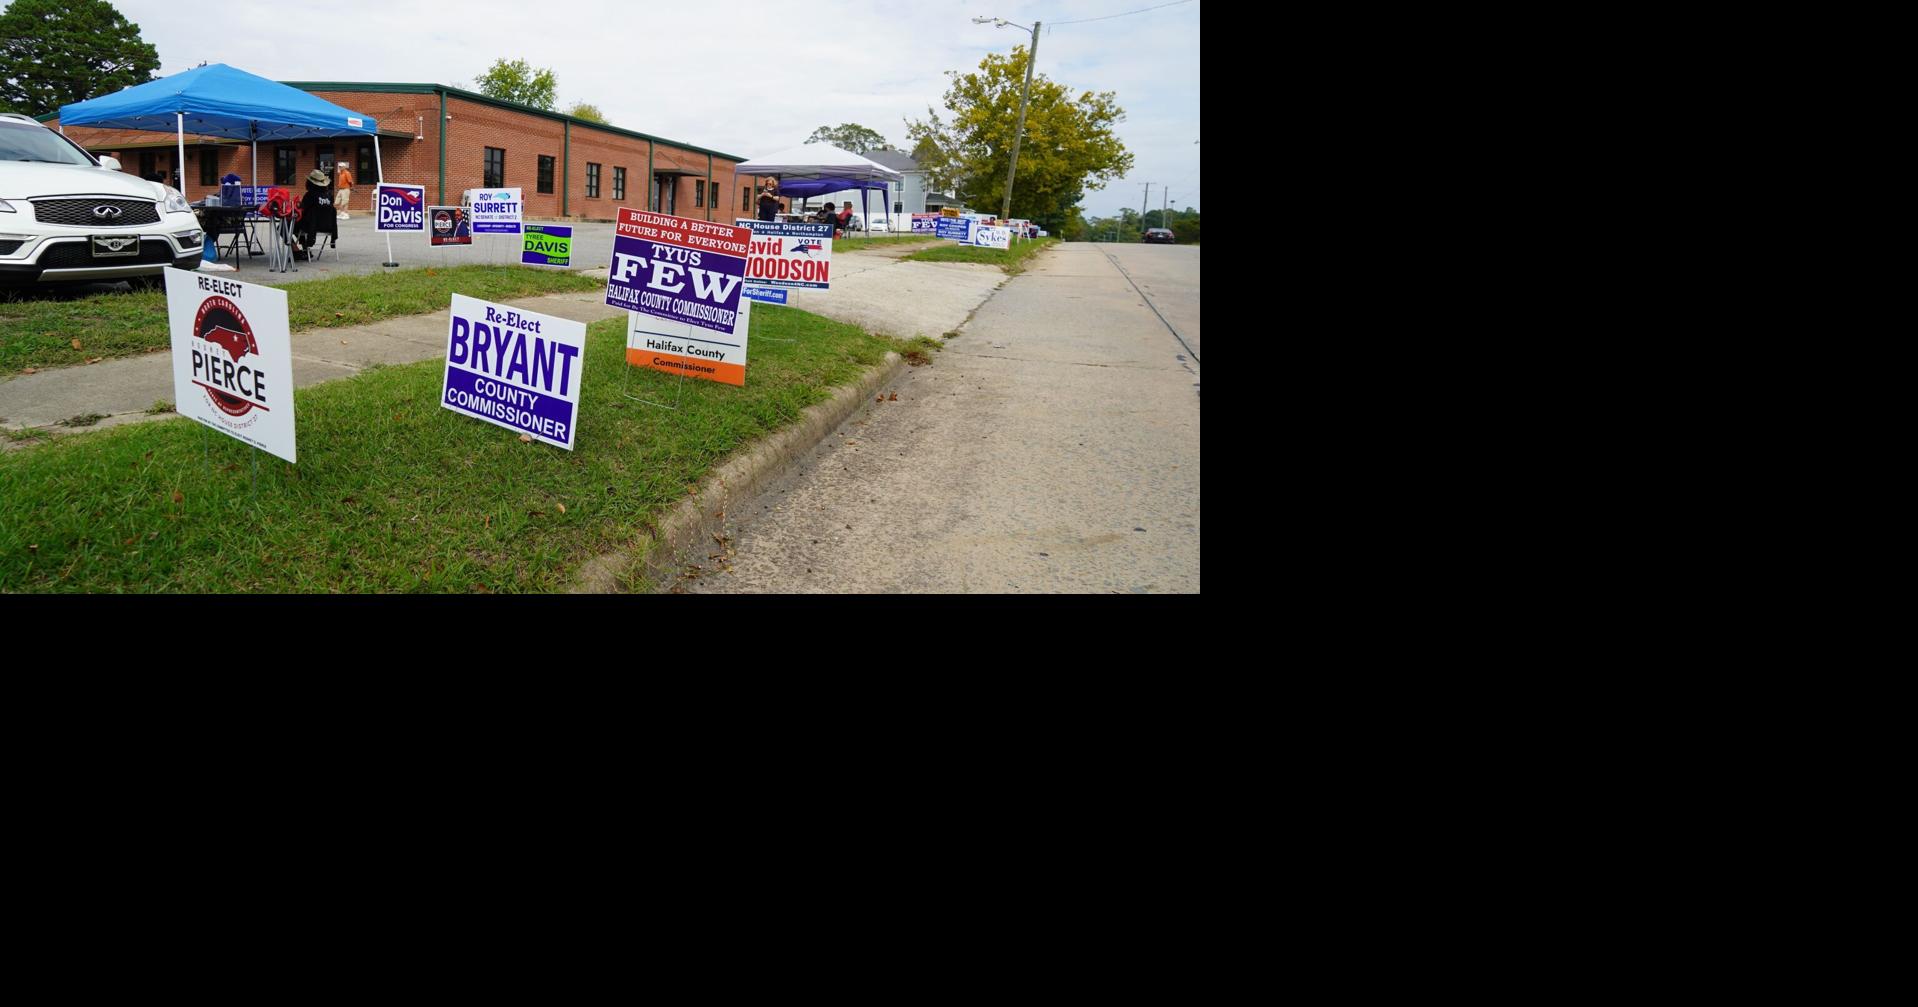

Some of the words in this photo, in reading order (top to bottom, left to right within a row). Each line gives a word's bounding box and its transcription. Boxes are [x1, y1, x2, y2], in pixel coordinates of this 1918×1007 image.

[381, 194, 402, 206] Don
[474, 203, 517, 213] SURRETT
[380, 206, 422, 223] Davis
[630, 212, 678, 228] BUILDING
[691, 223, 733, 238] BETTER
[524, 241, 568, 253] DAVIS
[618, 223, 657, 237] FUTURE
[660, 231, 682, 241] FOR
[688, 235, 747, 253] EVERYONE
[750, 237, 782, 256] avid
[979, 232, 1006, 242] Sykes
[652, 244, 702, 266] TYUS
[198, 276, 242, 298] RE-ELECT
[612, 252, 743, 304] FEW
[201, 299, 216, 314] NORTH
[218, 299, 245, 324] CAROLINA
[608, 284, 640, 304] HALIFAX
[641, 292, 674, 311] COUNTY
[672, 298, 735, 326] COMMISSIONER
[485, 306, 541, 333] Re-Elect
[449, 316, 578, 396] BRYANT
[647, 339, 683, 353] Halifax
[686, 346, 725, 361] County
[192, 349, 266, 402] PIERCE
[653, 358, 716, 374] Commissioner
[475, 378, 538, 410] COUNTY
[447, 388, 566, 440] COMMISSIONER
